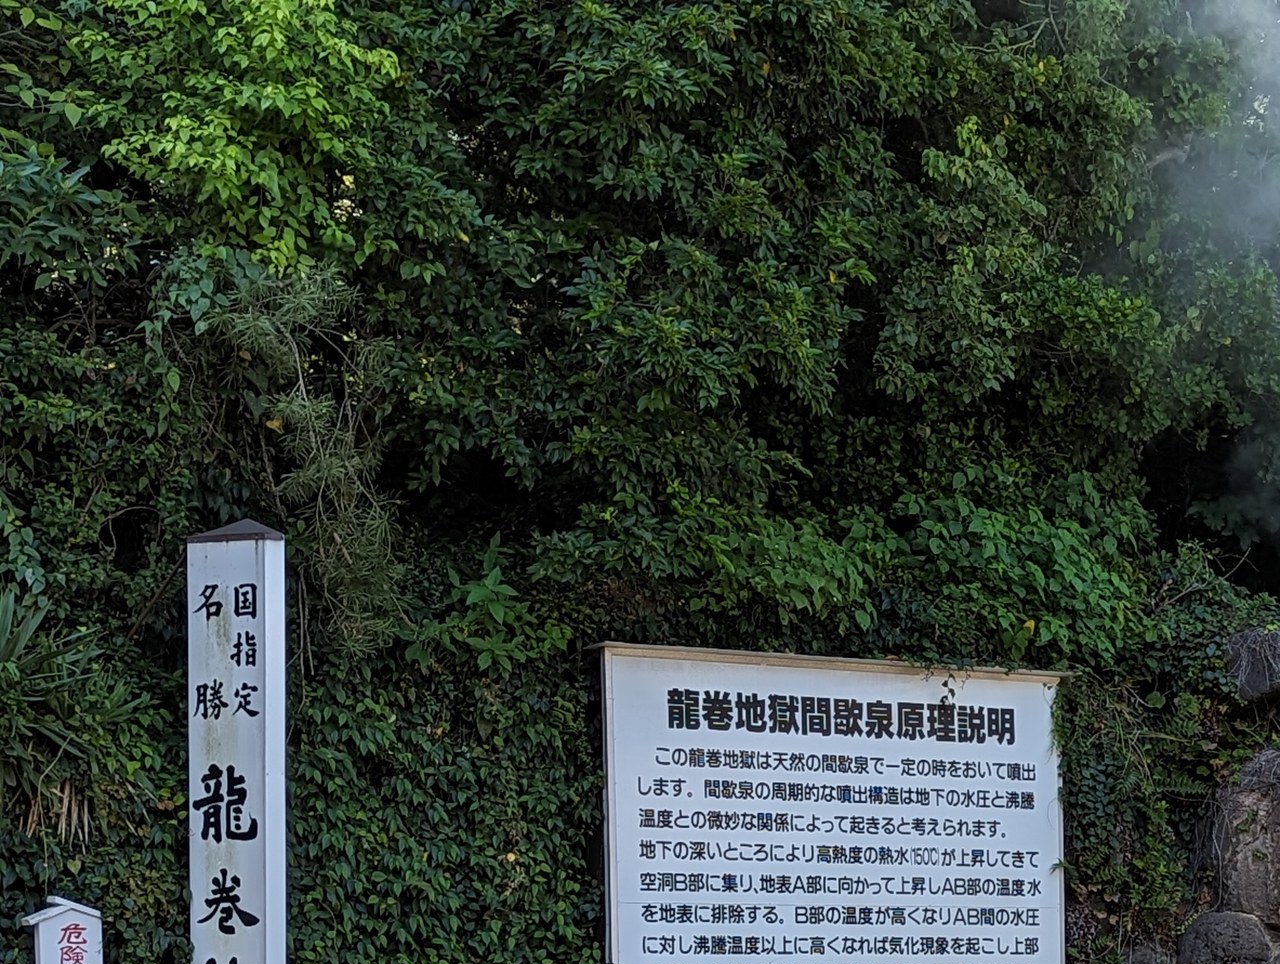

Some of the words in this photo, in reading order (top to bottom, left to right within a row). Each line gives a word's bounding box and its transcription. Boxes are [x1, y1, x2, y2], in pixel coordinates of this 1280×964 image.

[230, 583, 261, 719] 国指定
[667, 688, 1017, 746] 龍巻地獄間歇泉原理説明
